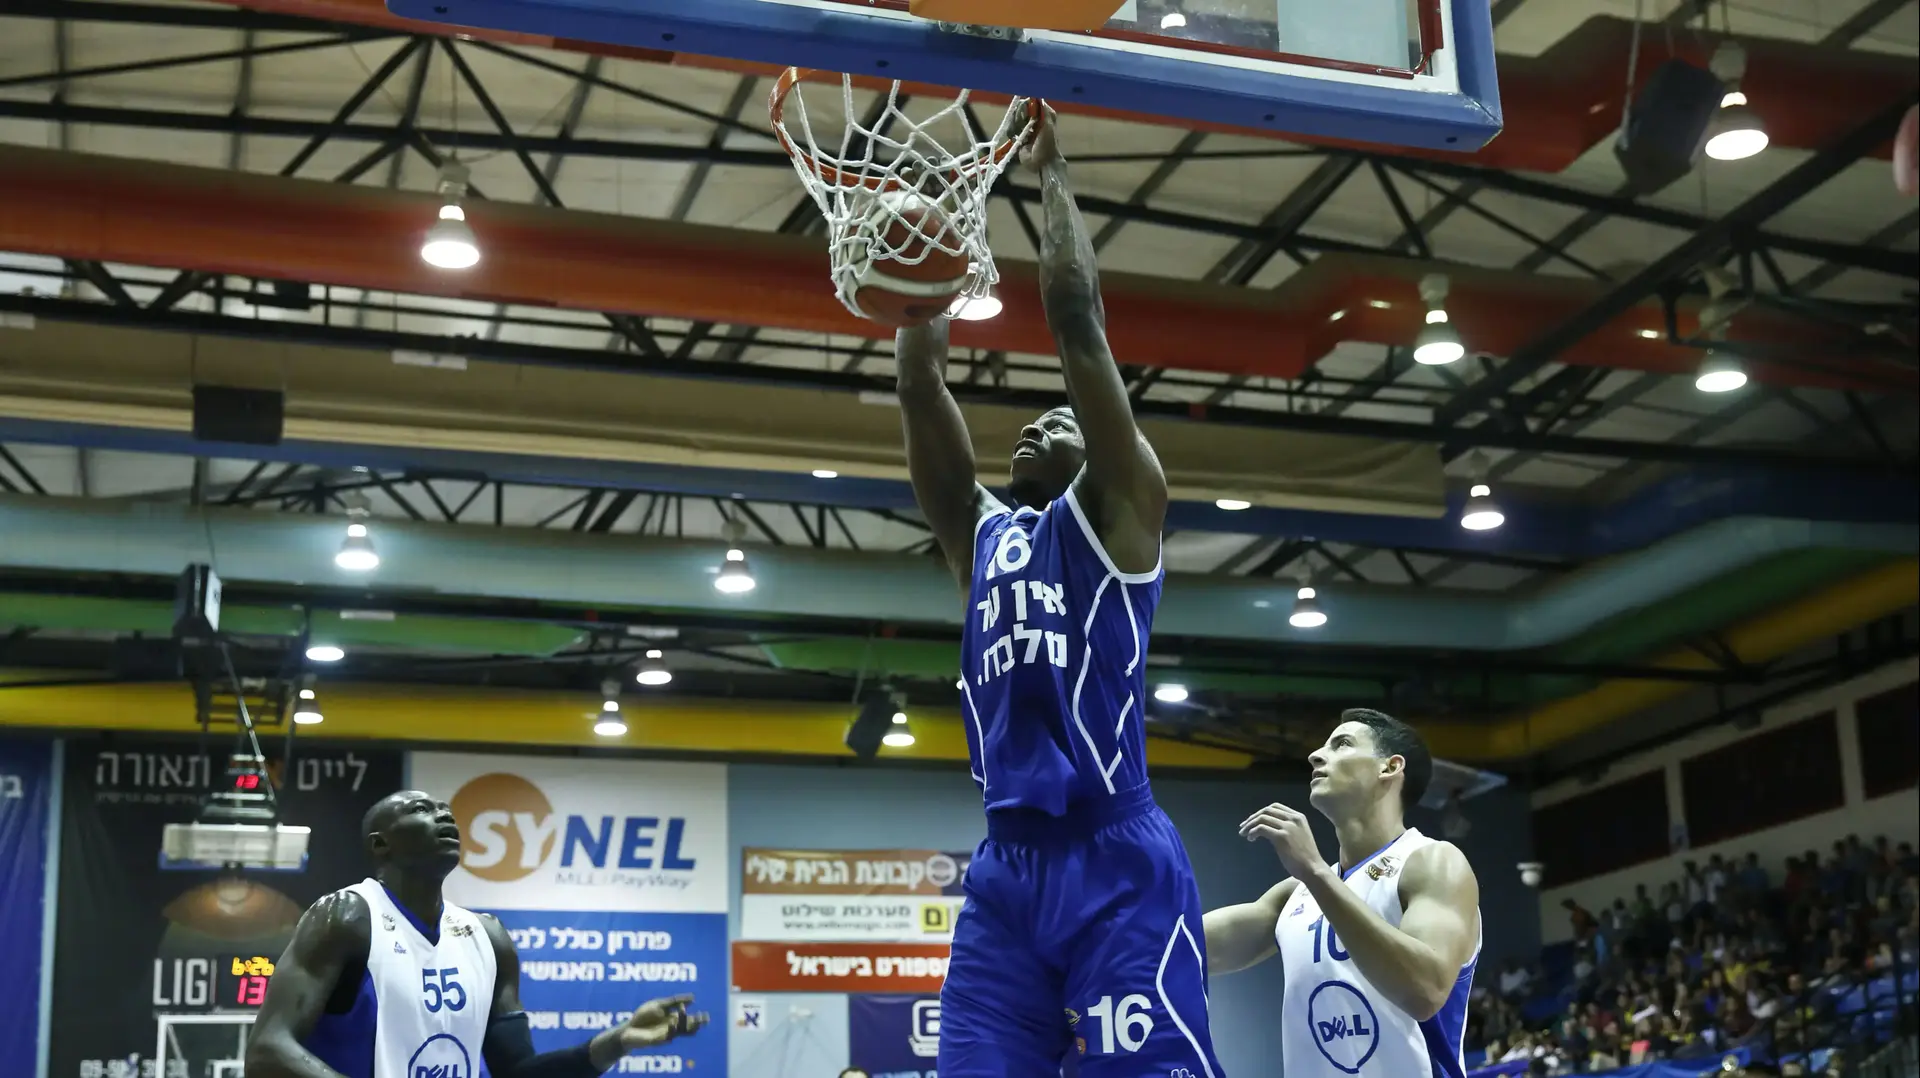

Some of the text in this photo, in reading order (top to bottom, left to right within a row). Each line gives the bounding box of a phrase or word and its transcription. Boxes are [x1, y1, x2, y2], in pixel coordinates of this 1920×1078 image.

[1011, 579, 1067, 621] אין
[978, 623, 1067, 686] מלבדו.
[96, 752, 368, 791] לייט תאורה
[463, 808, 696, 872] SYNEL
[746, 854, 924, 891] קבוצת הבית שלי
[606, 930, 672, 956] פתרון
[608, 961, 698, 983] המשאב
[786, 950, 873, 976] בישראל
[237, 976, 267, 1005] 13
[422, 967, 467, 1013] 55
[1087, 993, 1154, 1054] 16
[1317, 1014, 1370, 1043] DEL
